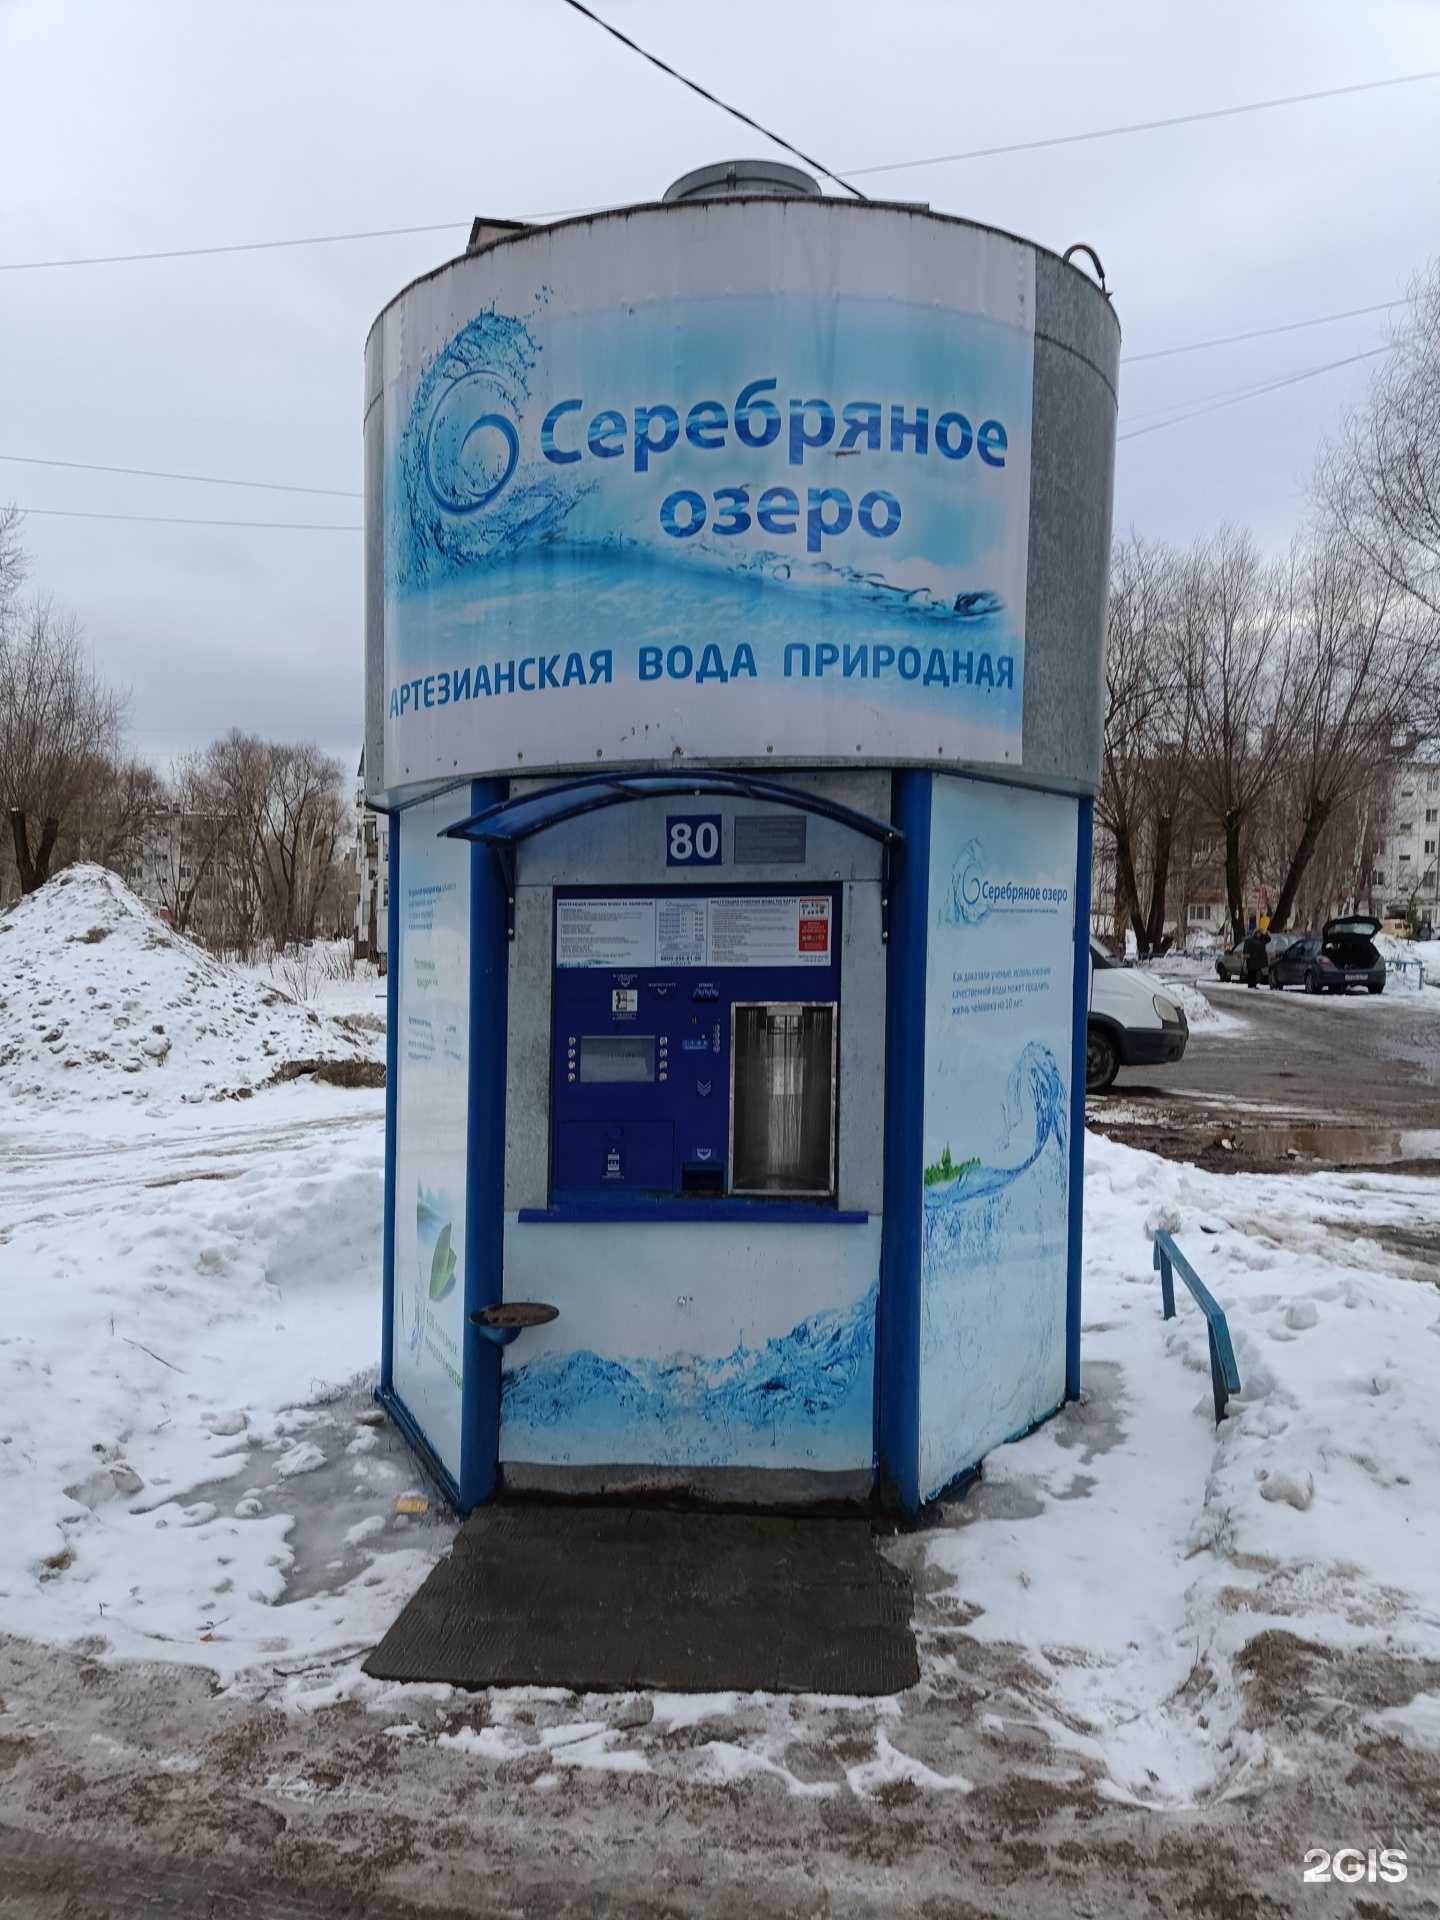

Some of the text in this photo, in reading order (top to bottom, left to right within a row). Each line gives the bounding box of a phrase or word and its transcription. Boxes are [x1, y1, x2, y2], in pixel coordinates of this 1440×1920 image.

[540, 376, 1008, 473] Серебряное
[659, 481, 902, 552] озеро
[389, 642, 1014, 719] АРТЕЗИАНСКАЯ ВОДА ПРИРОДНАЯ
[670, 821, 719, 860] 80
[982, 880, 1068, 904] Серебряное озеро
